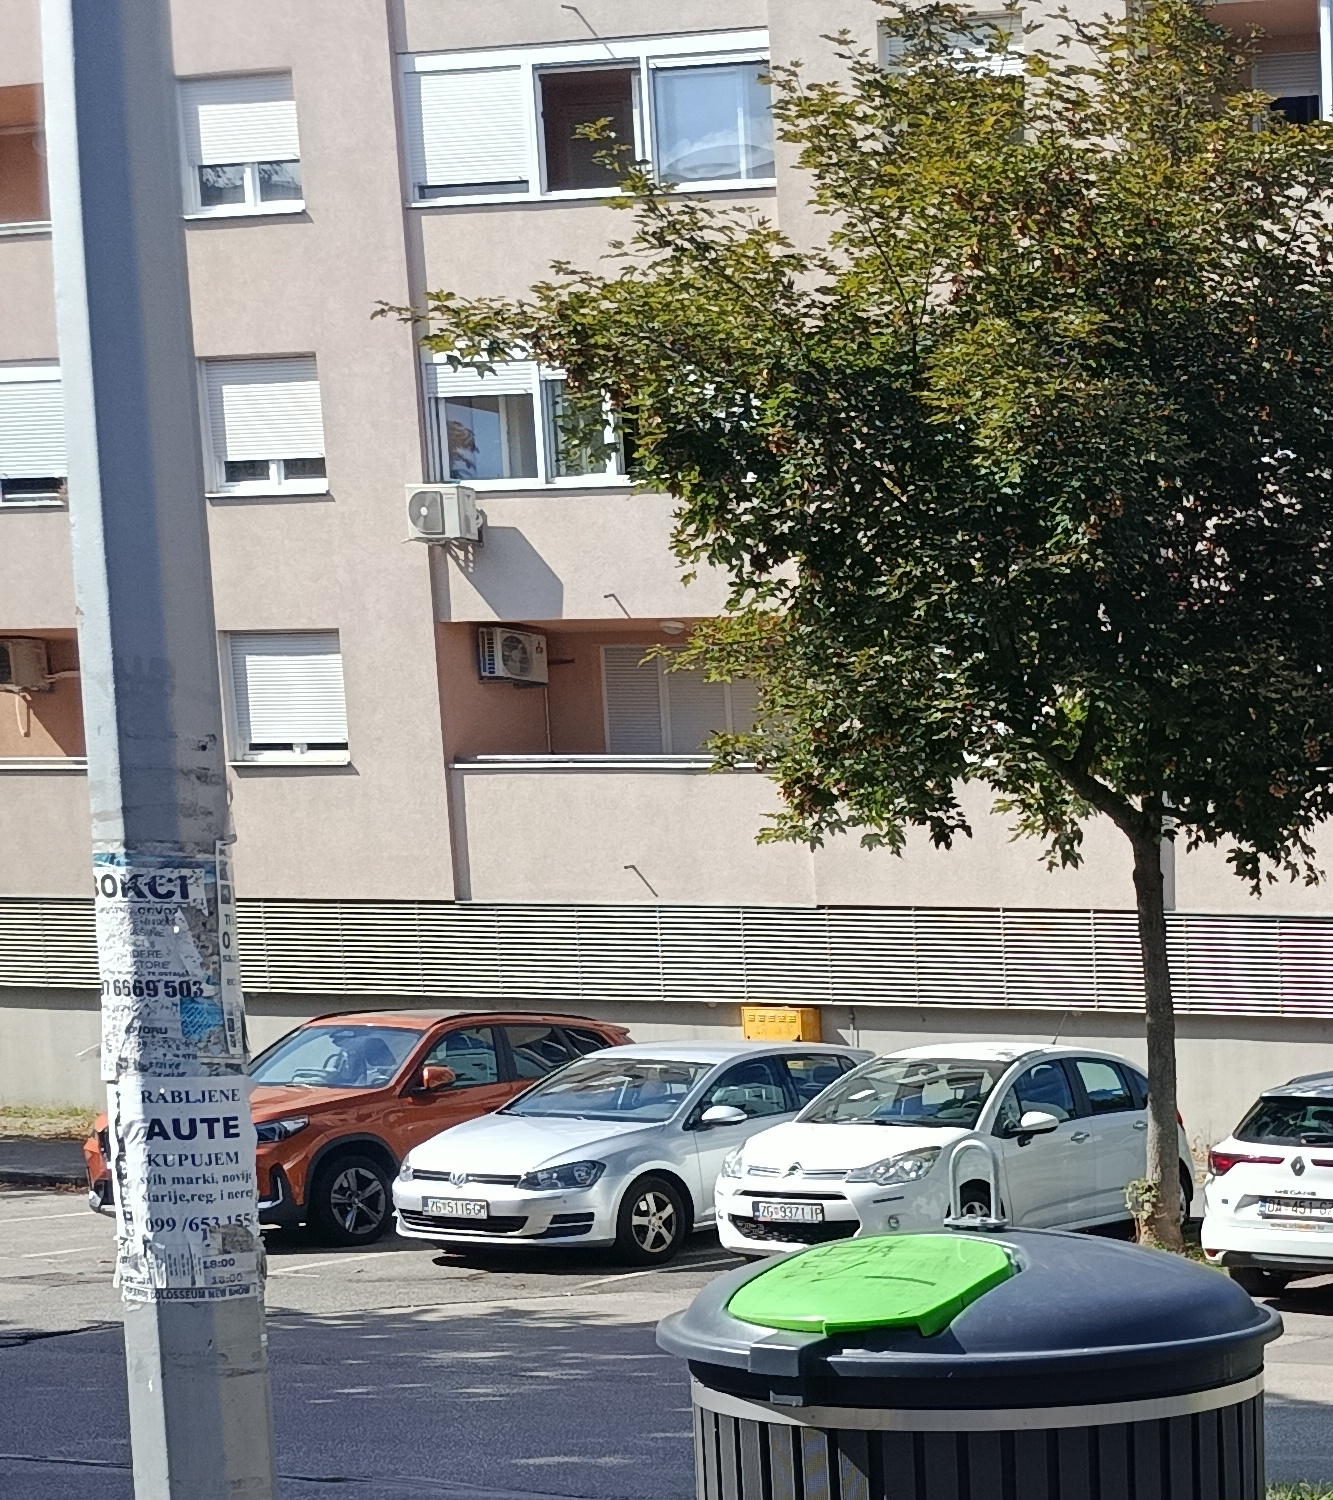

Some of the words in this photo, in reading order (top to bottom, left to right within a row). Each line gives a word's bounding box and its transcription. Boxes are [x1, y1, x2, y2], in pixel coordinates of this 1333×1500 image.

[140, 1088, 240, 1104] RABLJENE
[145, 1116, 240, 1141] AUTE
[146, 1151, 239, 1168] KUPUJEM
[145, 1217, 177, 1233] 099
